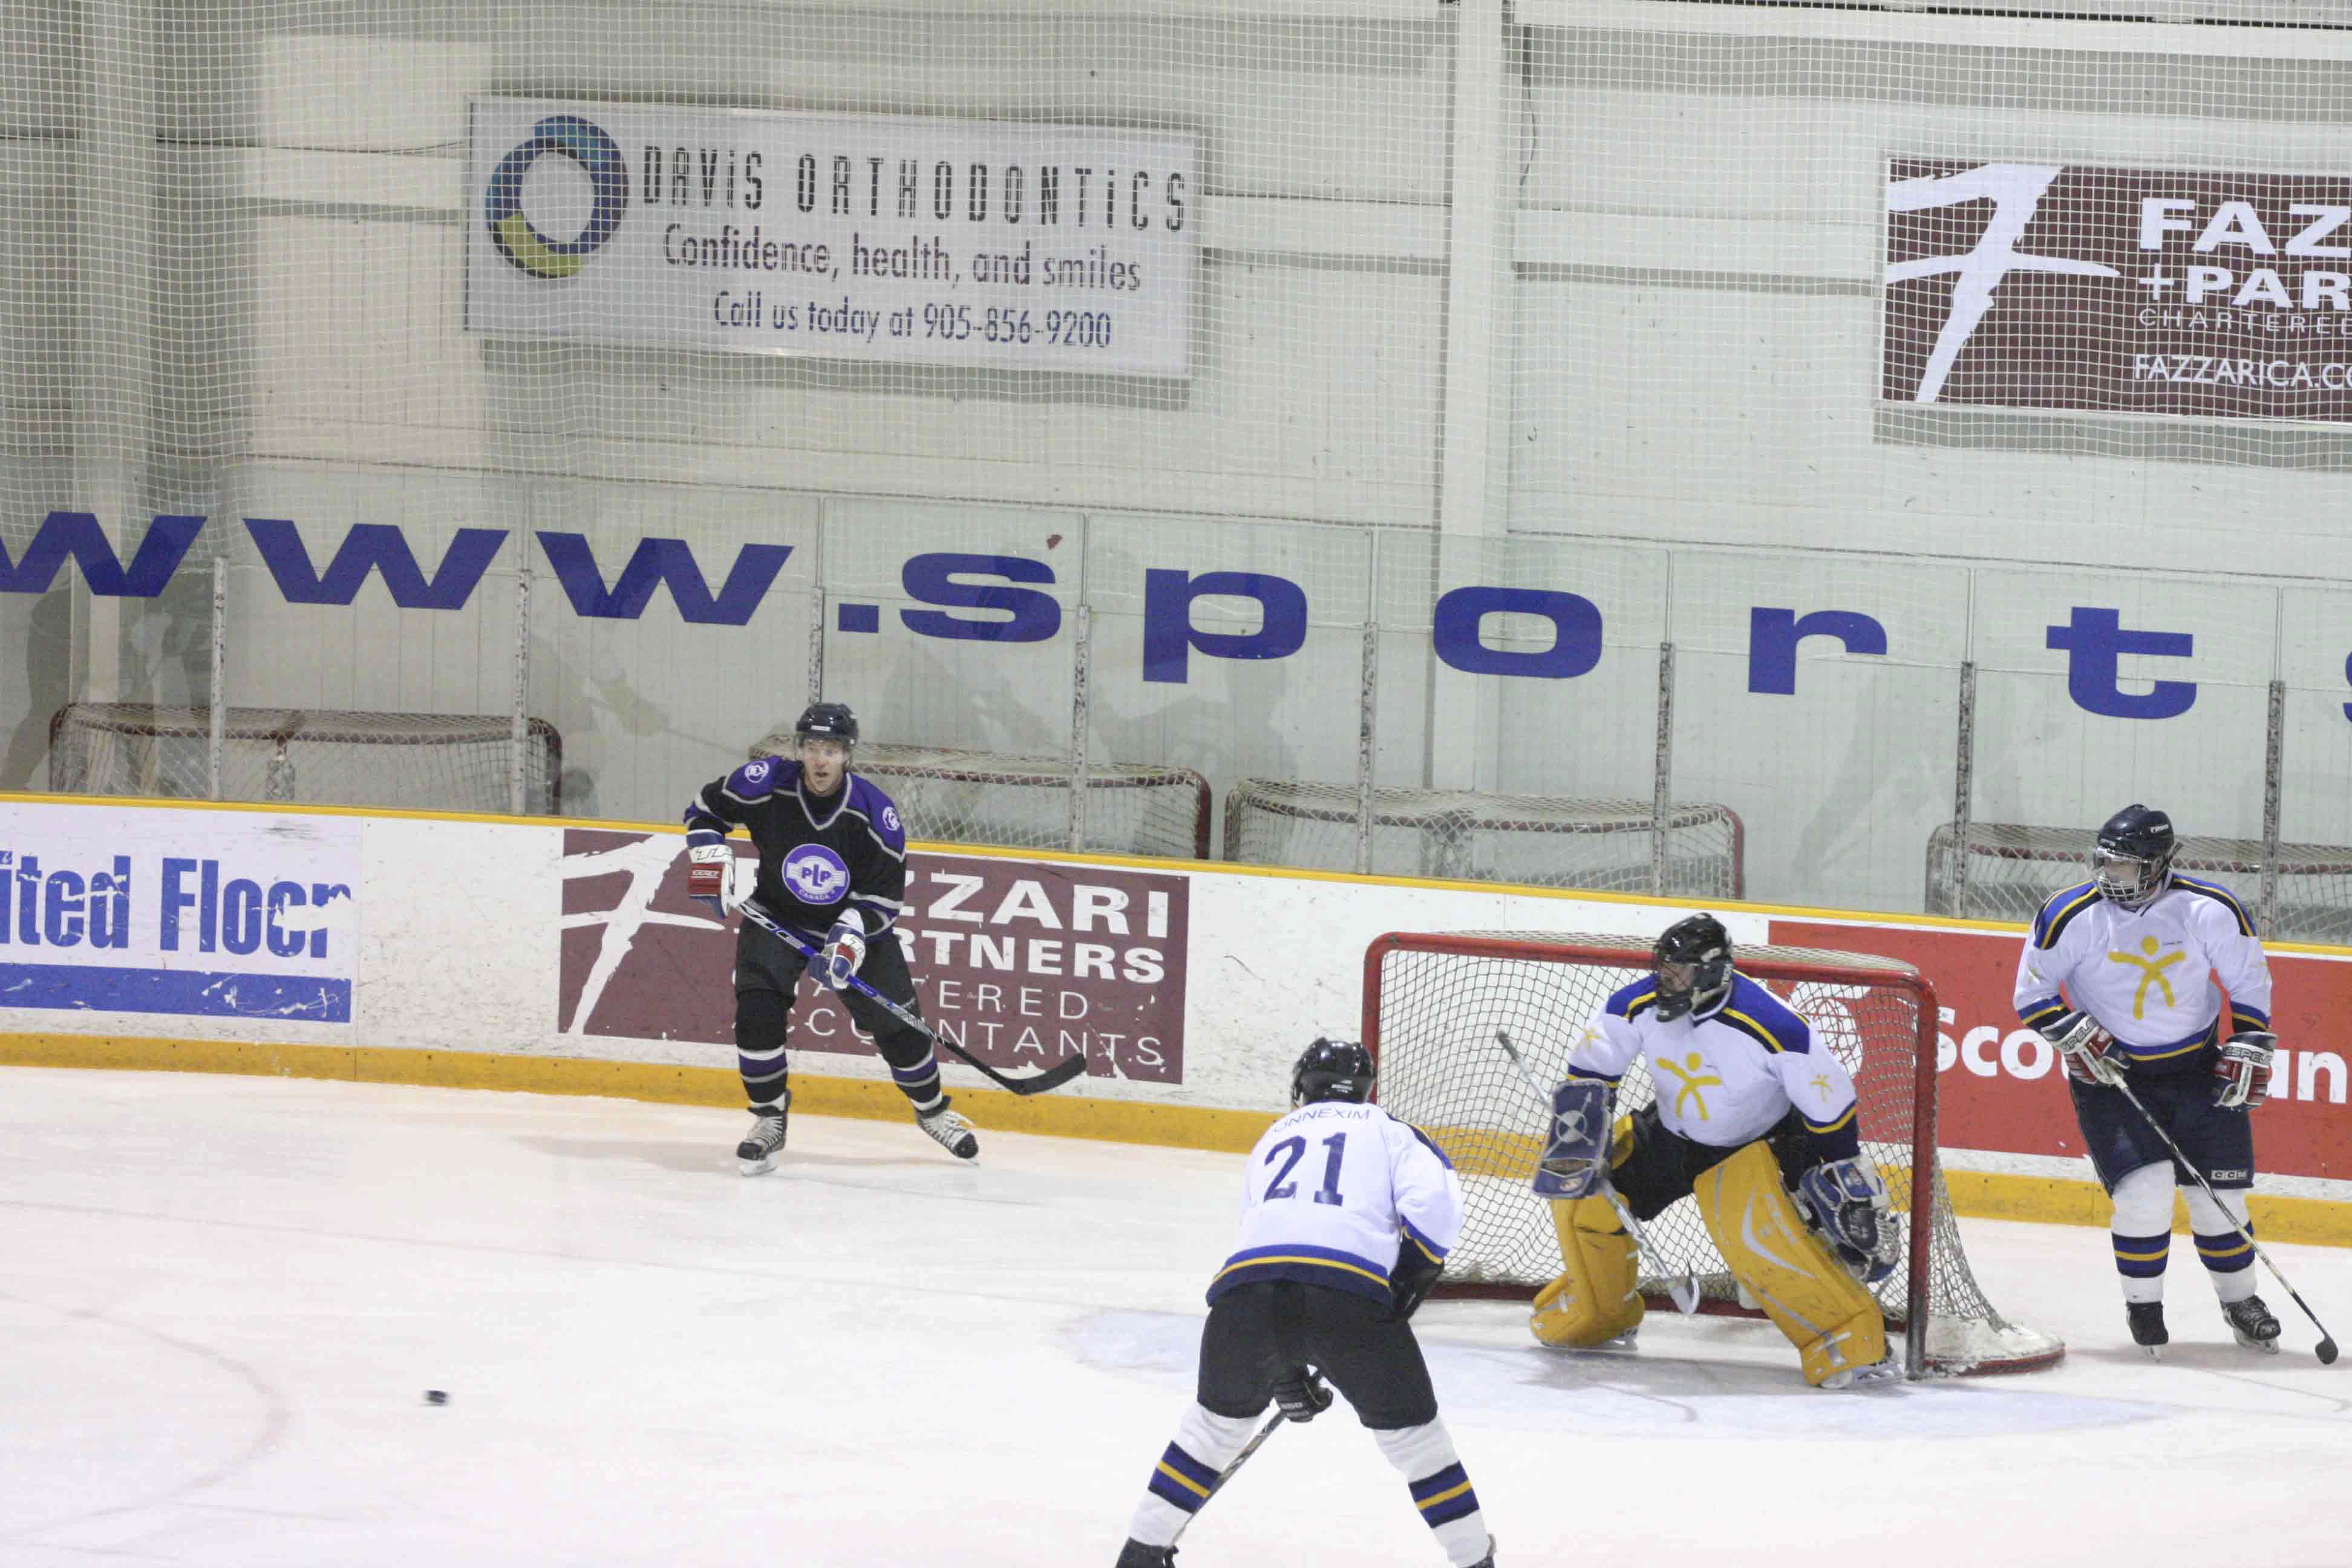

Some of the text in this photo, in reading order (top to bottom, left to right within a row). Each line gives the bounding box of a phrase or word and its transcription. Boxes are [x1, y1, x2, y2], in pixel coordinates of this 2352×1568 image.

[665, 223, 1141, 290] Confidence, health, and smiles
[2140, 197, 2351, 258] FAZ
[714, 290, 1111, 348] Call us today at 905-856-9200
[1263, 1132, 1347, 1206] 21
